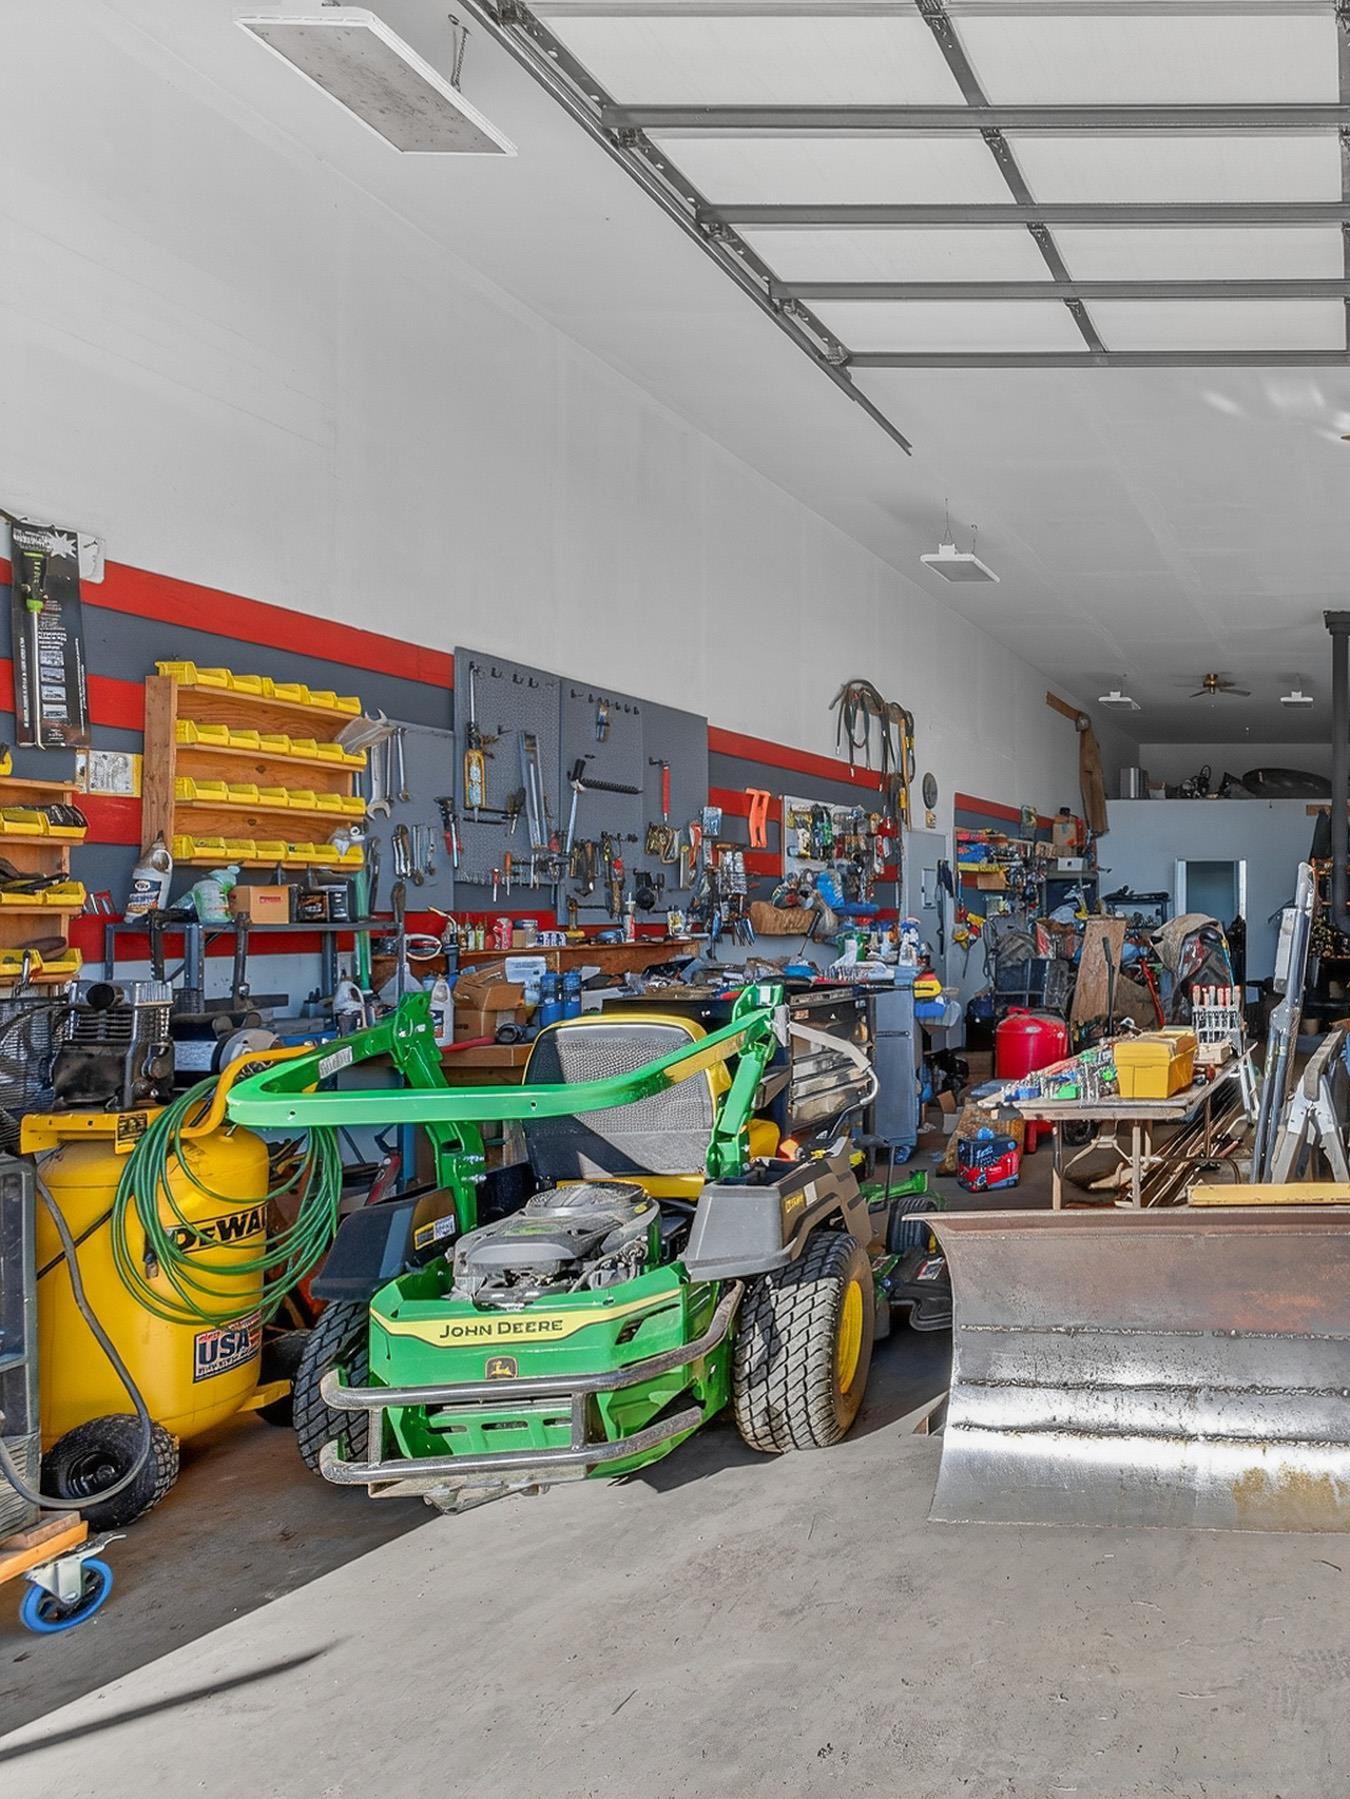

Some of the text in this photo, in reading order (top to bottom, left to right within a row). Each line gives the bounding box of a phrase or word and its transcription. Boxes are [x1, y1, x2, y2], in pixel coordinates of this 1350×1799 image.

[439, 1320, 563, 1338] JOHN DEERE
[198, 1327, 250, 1364] USA
